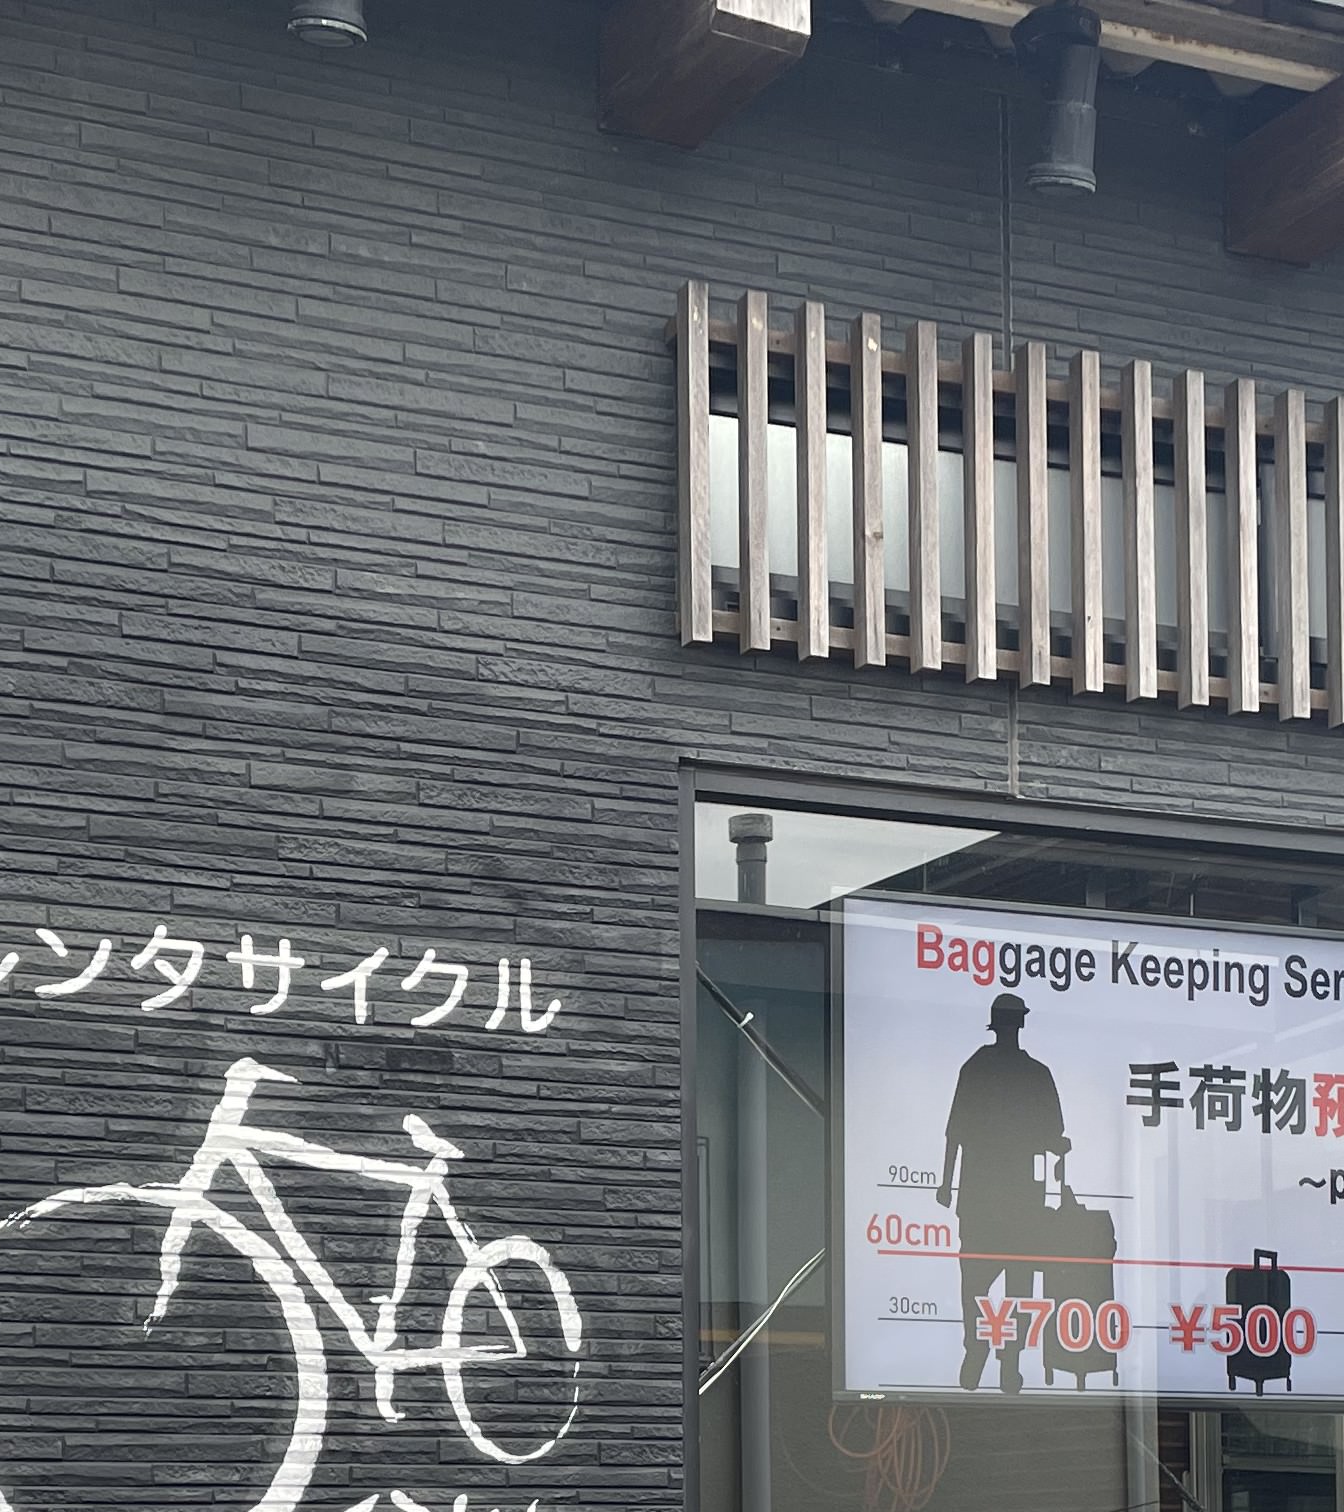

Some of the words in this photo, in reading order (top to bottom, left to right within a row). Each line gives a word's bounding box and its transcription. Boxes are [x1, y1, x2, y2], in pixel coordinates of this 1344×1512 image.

[916, 924, 1096, 991] Baggage
[1111, 941, 1269, 1006] Keeping
[888, 1165, 936, 1187] 90cm
[866, 1215, 951, 1247] 60cm
[889, 1297, 937, 1317] 30cm
[977, 1297, 1130, 1353] ¥700
[1170, 1304, 1316, 1357] ¥500
